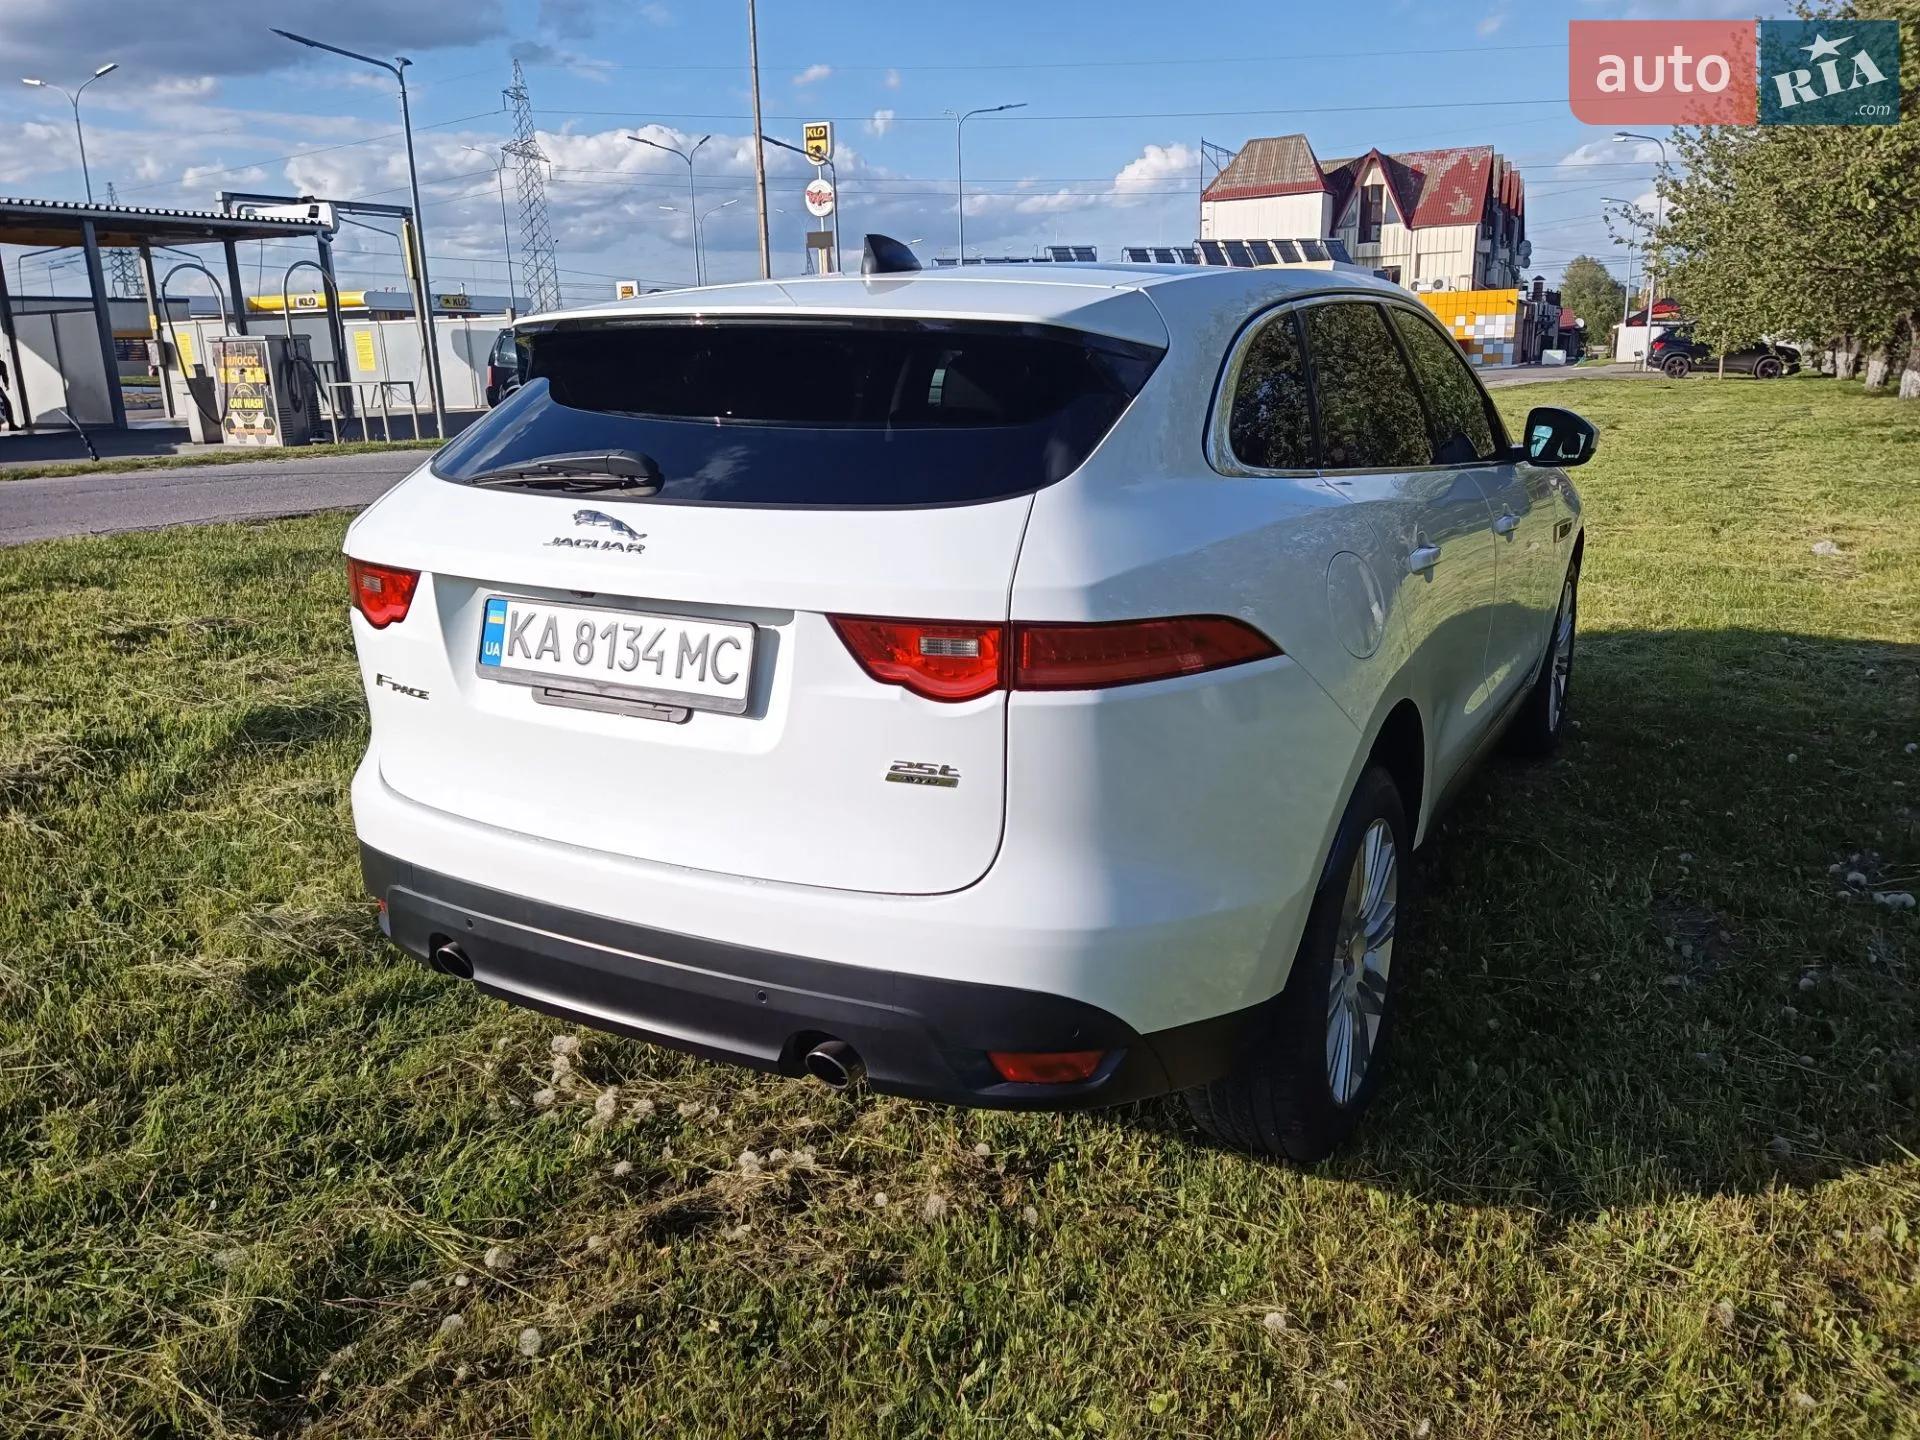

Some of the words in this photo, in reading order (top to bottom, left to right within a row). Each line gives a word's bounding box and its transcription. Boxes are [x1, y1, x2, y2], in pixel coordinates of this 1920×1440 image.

[806, 127, 826, 138] KLO
[299, 297, 316, 307] KLO
[453, 296, 468, 307] KLO
[229, 397, 243, 409] CAR
[244, 397, 264, 409] WASH
[543, 537, 646, 554] JAGUAR
[485, 641, 500, 657] UA
[507, 610, 561, 662] KA
[573, 618, 666, 675] 8134
[675, 629, 742, 685] MC
